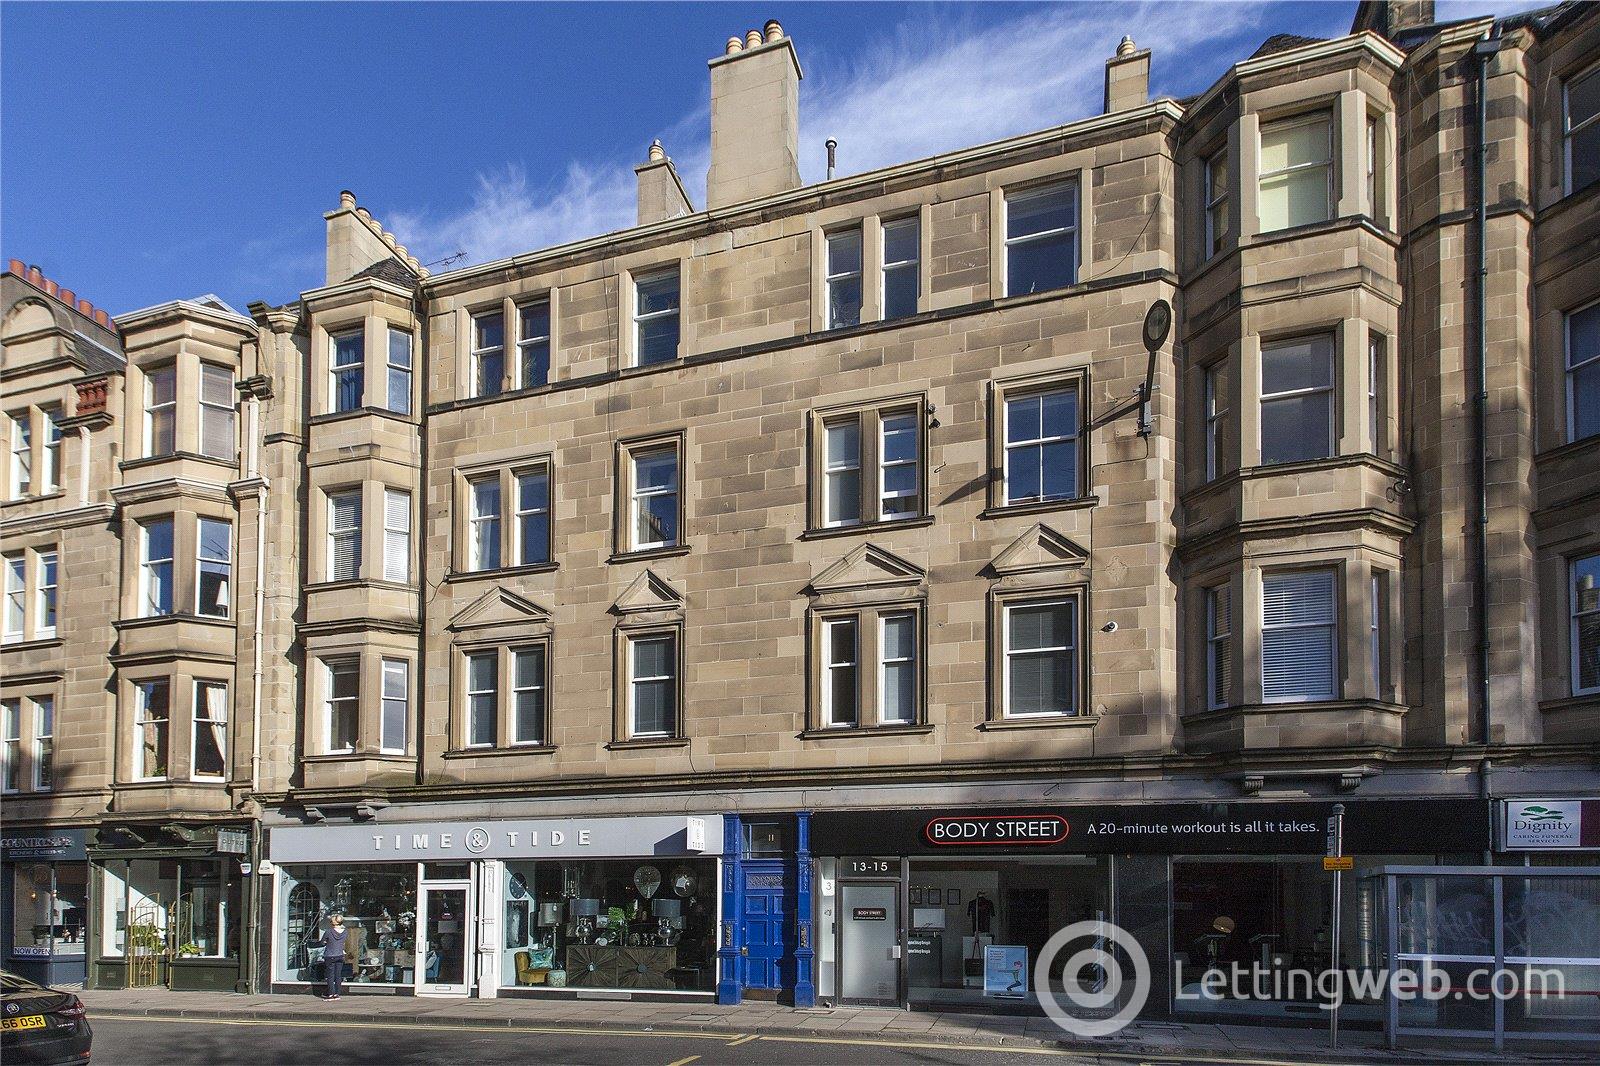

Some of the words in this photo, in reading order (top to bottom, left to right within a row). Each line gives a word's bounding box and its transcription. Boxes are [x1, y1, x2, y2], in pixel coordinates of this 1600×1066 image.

[934, 823, 989, 838] BODY
[995, 821, 1060, 837] STREET
[1087, 823, 1097, 834] A
[1099, 822, 1168, 834] 20-minute
[1171, 822, 1226, 833] workout
[1230, 821, 1241, 833] is
[1245, 820, 1262, 832] all
[1265, 821, 1275, 832] it
[1279, 820, 1320, 832] takes.
[1514, 820, 1572, 834] Dignity
[372, 834, 452, 850] TIME
[472, 832, 484, 848] &
[507, 829, 591, 847] TIDE
[852, 862, 888, 872] 13-15
[0, 1019, 18, 1029] 66
[20, 1016, 43, 1027] OSR
